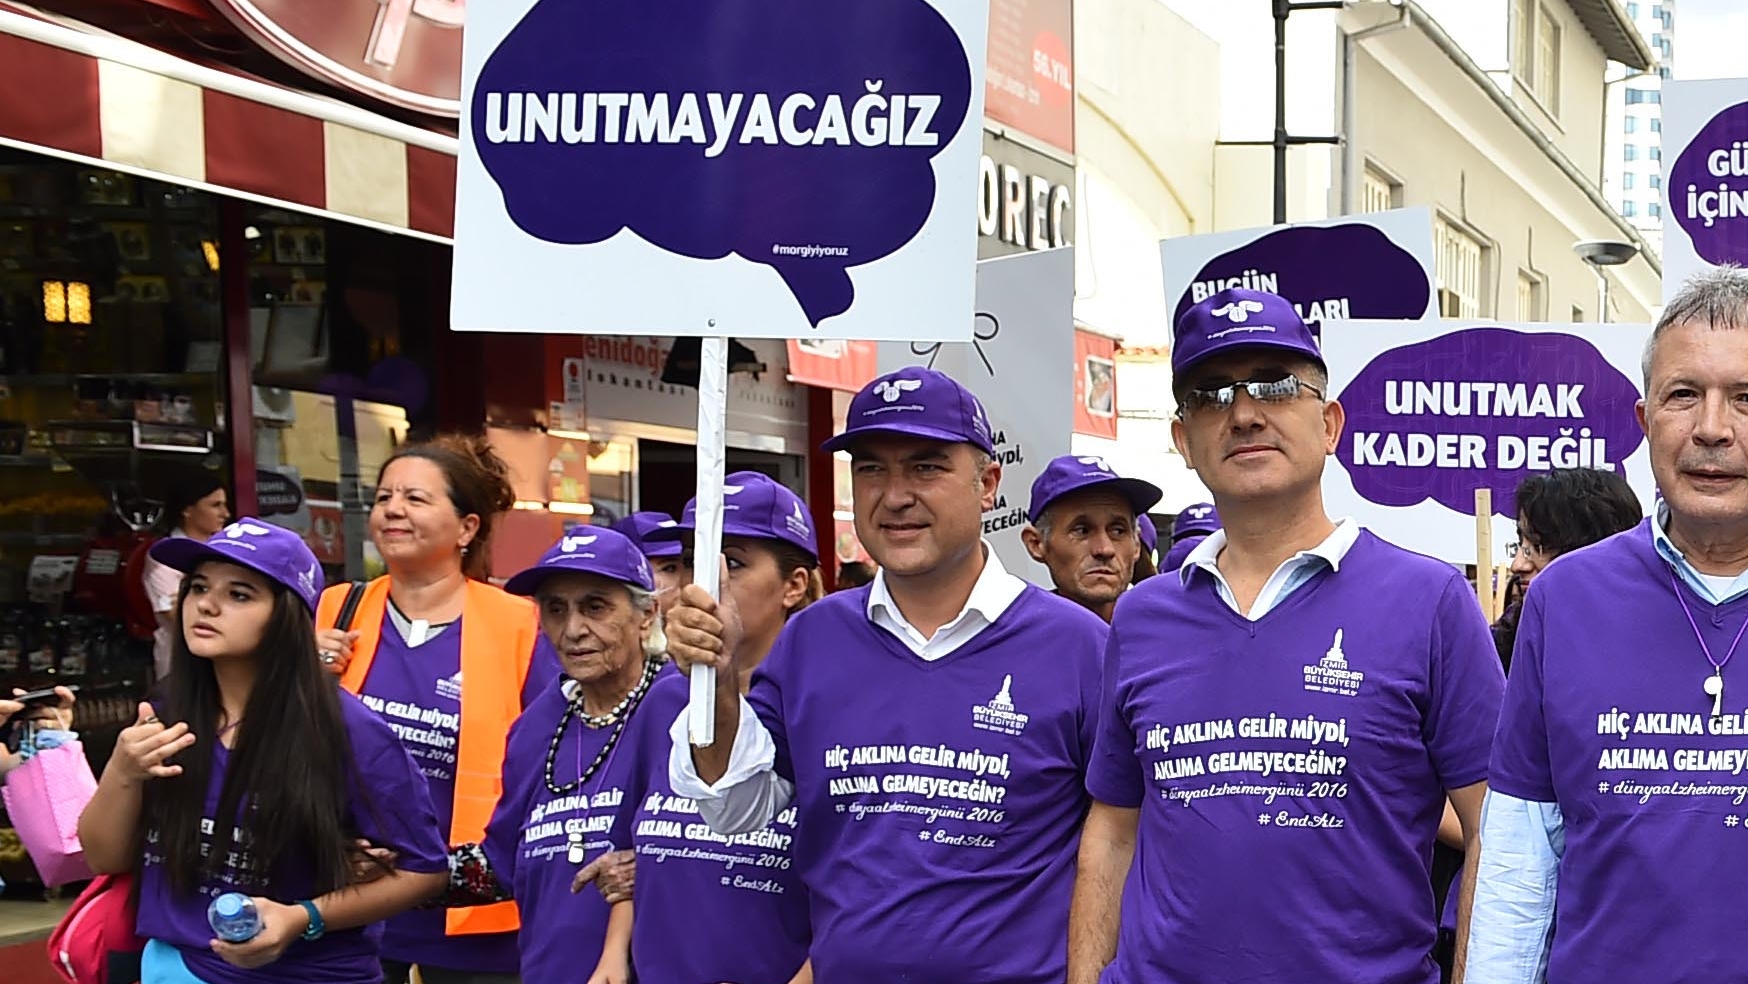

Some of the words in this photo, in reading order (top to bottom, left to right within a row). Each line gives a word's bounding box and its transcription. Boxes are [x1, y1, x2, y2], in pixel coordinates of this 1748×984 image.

[486, 80, 942, 157] UNUTMAYACAĞIZ
[1385, 380, 1584, 418] UNUTMAK
[1353, 432, 1487, 468] KADER
[1497, 427, 1616, 471] DEĞİL
[1146, 723, 1170, 753] HİÇ
[1173, 719, 1235, 745] AKLINA
[1238, 712, 1287, 738] GELİR
[1290, 714, 1350, 748] MİYDİ,
[1597, 707, 1630, 740] HİÇ
[1633, 713, 1704, 734] AKLINA
[825, 745, 850, 772] HİÇ
[851, 746, 906, 766] AKLINA
[908, 745, 955, 768] GELİR
[957, 749, 1011, 780] MİYDİ,
[1154, 756, 1206, 780] AKLIMA
[1208, 749, 1347, 777] GELMEYECEĞİN?
[1598, 748, 1669, 770] AKLIMA
[882, 775, 1006, 804] GELMEYECEĞİN?
[1307, 781, 1348, 798] 2016
[966, 807, 1004, 823] 2016
[1275, 810, 1344, 828] EndAlz
[934, 830, 996, 848] EndAlz
[755, 854, 792, 870] 2016
